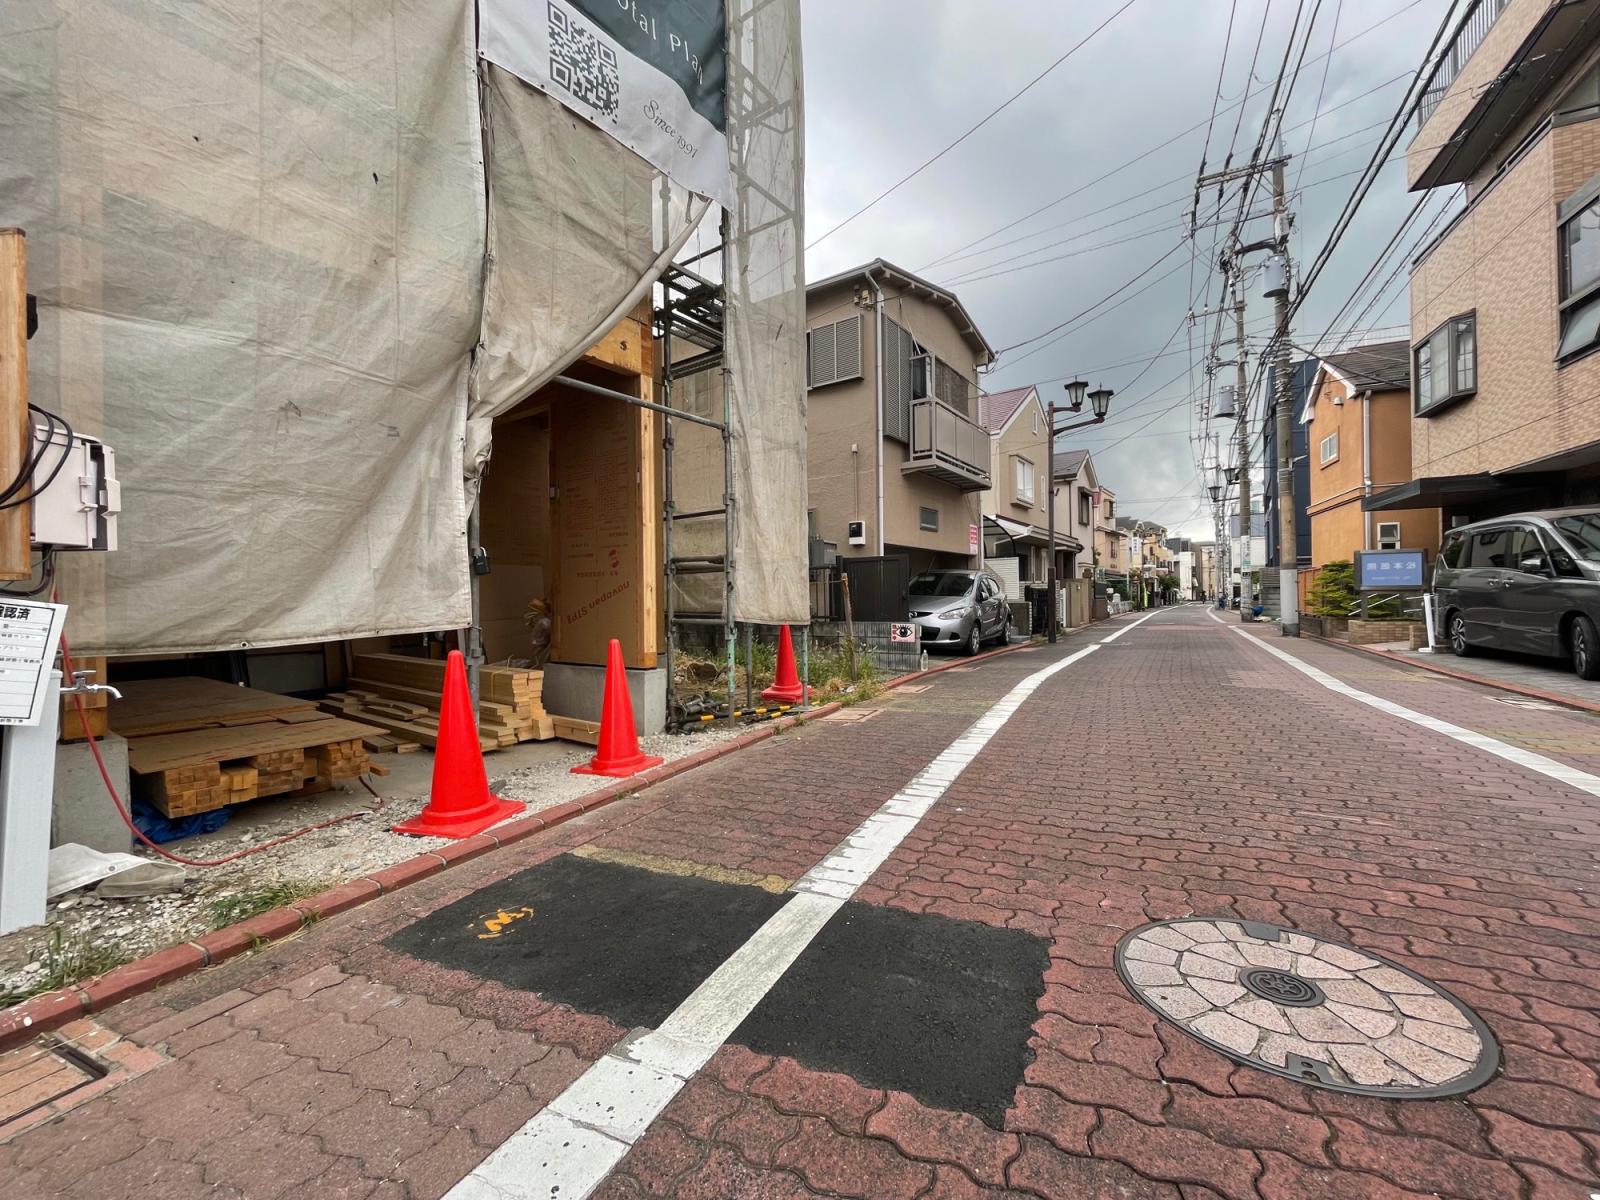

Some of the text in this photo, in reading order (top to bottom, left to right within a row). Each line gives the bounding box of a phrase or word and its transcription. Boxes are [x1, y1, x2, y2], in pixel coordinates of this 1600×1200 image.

[669, 33, 703, 85] Plan
[643, 99, 699, 159] Since 1991
[589, 581, 630, 609] novopan
